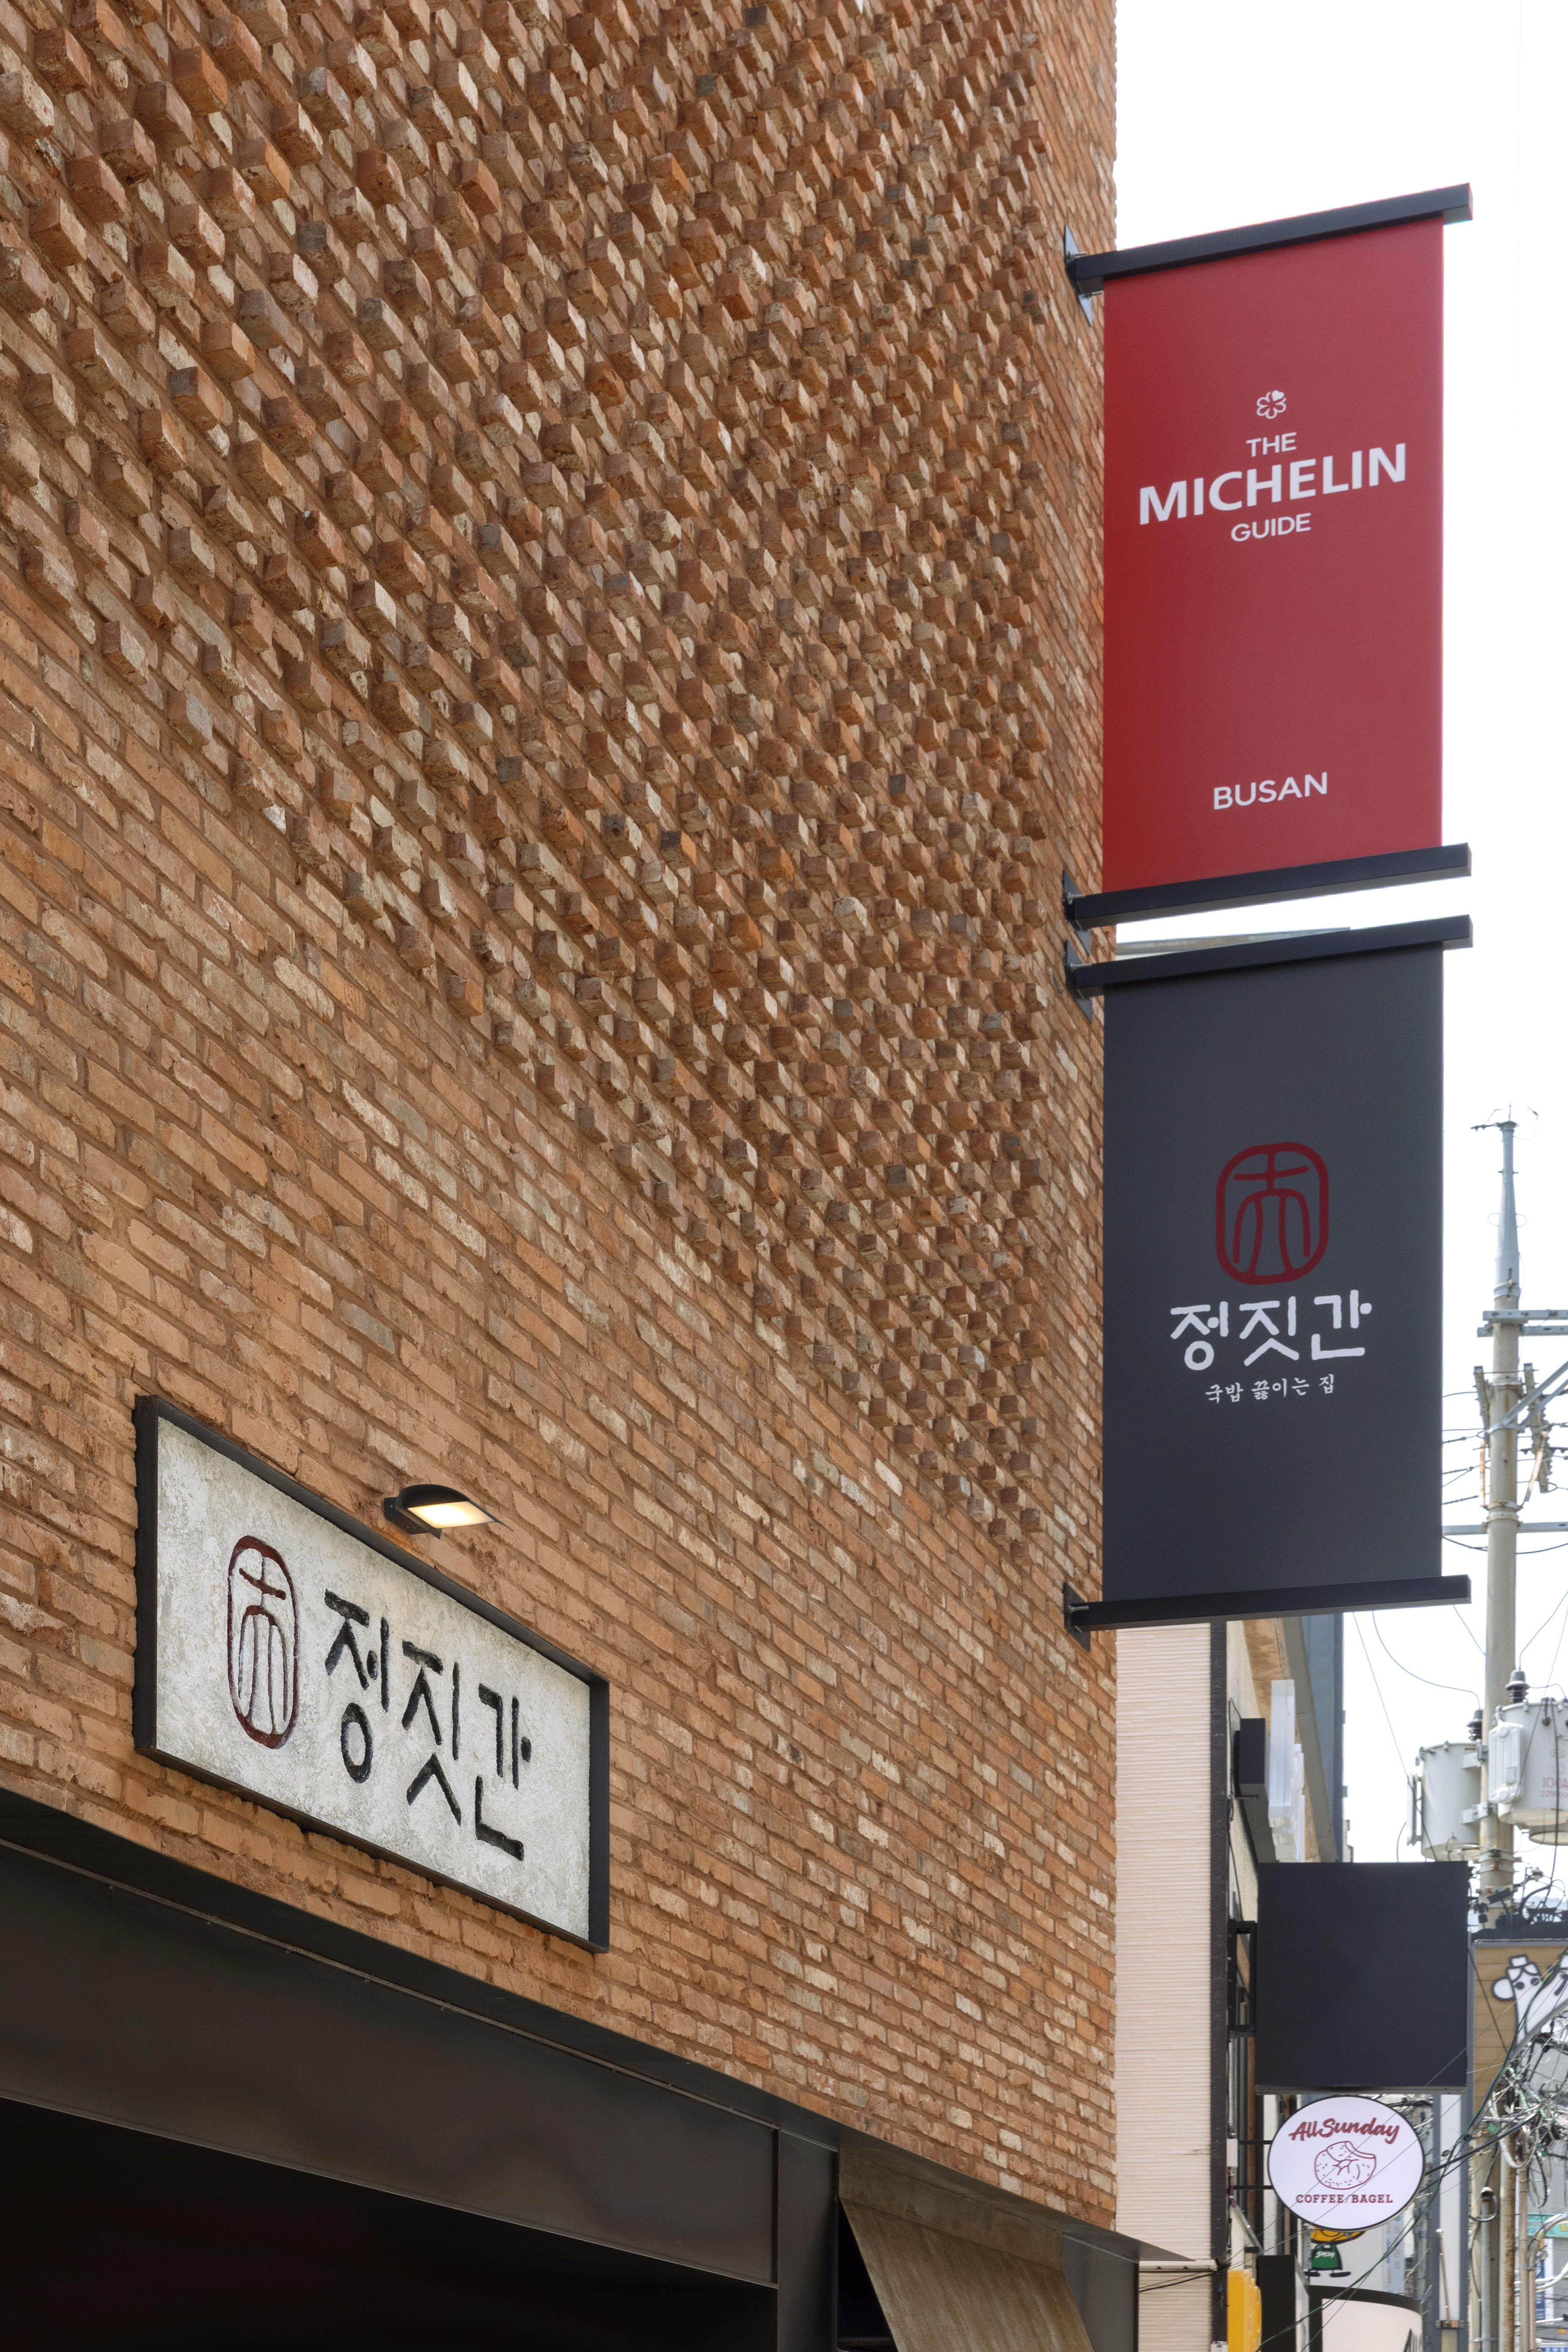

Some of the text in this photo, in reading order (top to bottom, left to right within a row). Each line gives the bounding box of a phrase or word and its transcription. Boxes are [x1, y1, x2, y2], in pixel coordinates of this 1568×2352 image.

[1246, 432, 1297, 457] THE
[1139, 443, 1406, 525] MICHELIN
[1231, 512, 1311, 542] GUIDE
[1213, 772, 1328, 810] BUSAN
[1170, 1289, 1372, 1371] 정짓간
[1205, 1373, 1335, 1404] 국밥 끓이는 집
[325, 1589, 532, 1862] 정짓간
